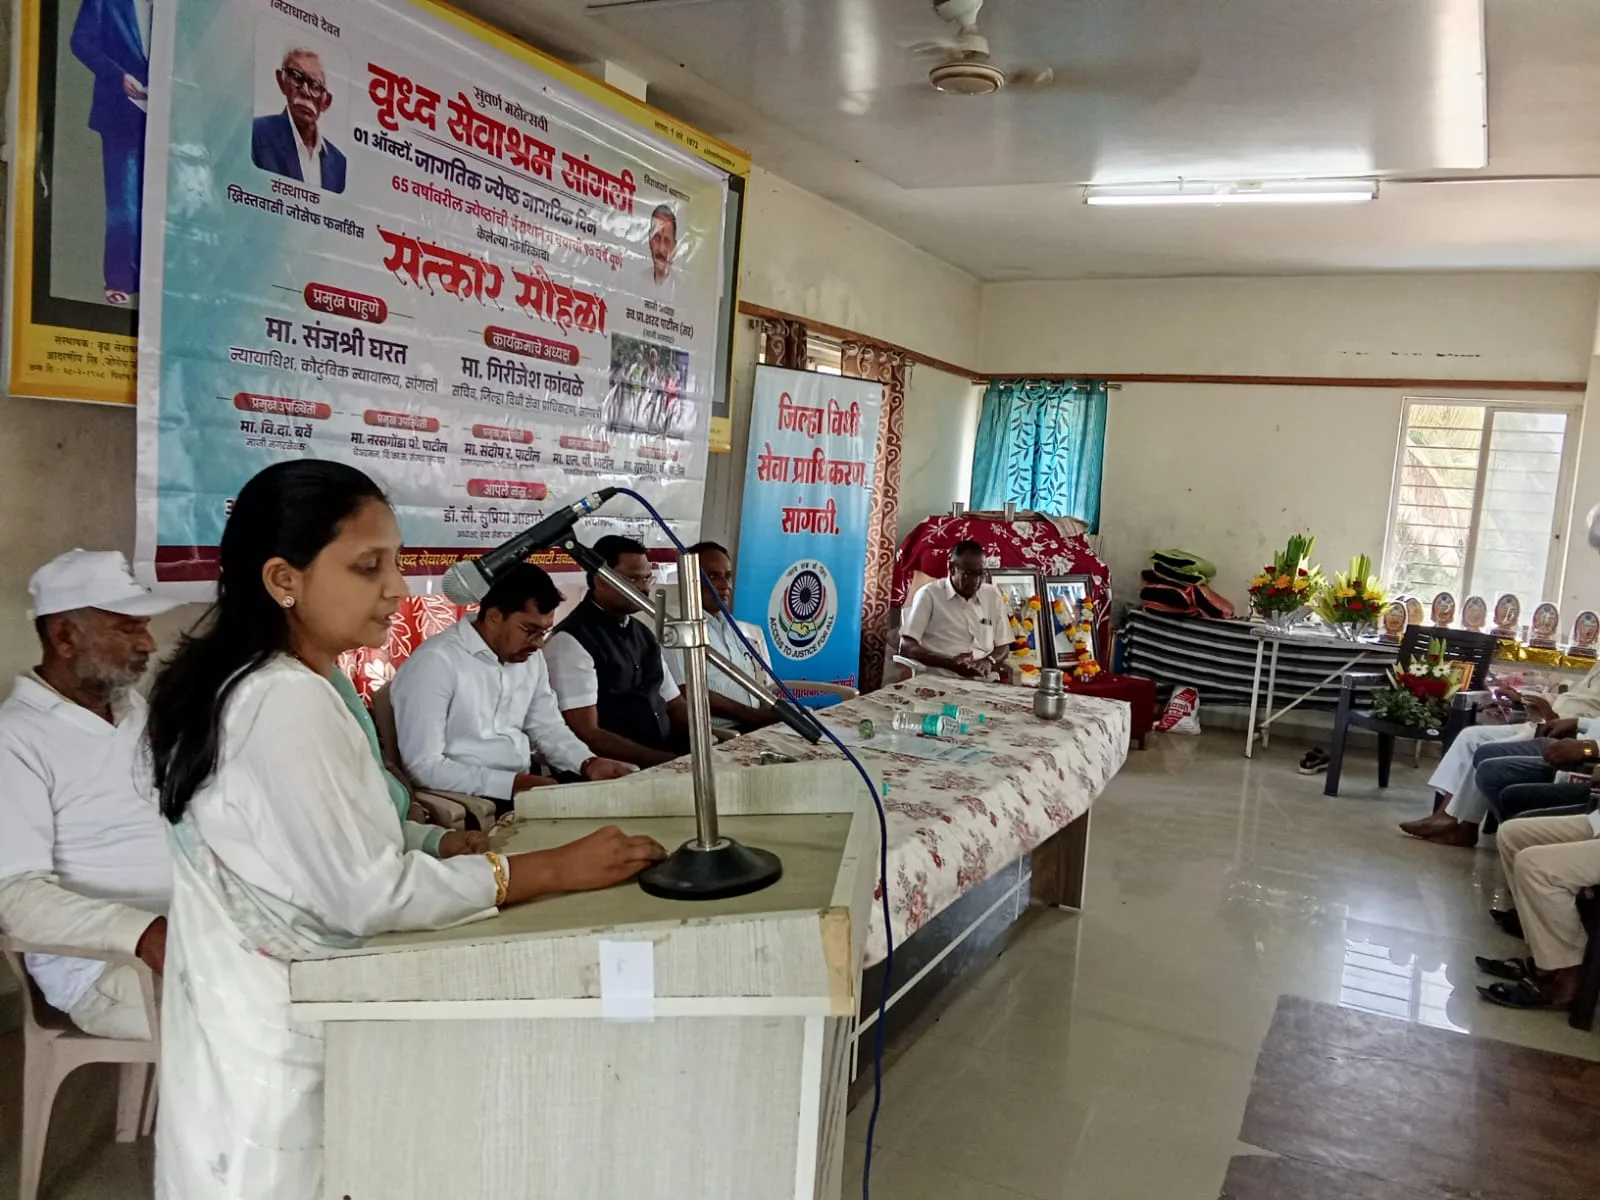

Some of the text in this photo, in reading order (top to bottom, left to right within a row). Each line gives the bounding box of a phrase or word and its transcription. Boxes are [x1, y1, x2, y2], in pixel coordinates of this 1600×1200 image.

[473, 86, 549, 132] सुवर्ण महोत्सवी
[368, 62, 441, 131] वृध्द
[447, 92, 556, 180] सेवाश्रम
[561, 154, 636, 215] सांगली
[353, 126, 369, 145] 01
[415, 150, 483, 191] जागतिक
[485, 176, 521, 205] ज्येष्ठ
[270, 179, 320, 205] संस्थापक
[392, 176, 408, 193] 65
[411, 180, 463, 211] वर्षावरील
[286, 204, 321, 226] जोसेफ
[476, 224, 508, 249] केलेल्या
[376, 224, 608, 338] सत्कार सोहळा
[312, 288, 379, 321] प्रमुख पाहुणे
[265, 317, 408, 365] मा. संजश्री घरत
[492, 332, 570, 362] कार्यक्रमाचे अध्यक्ष
[301, 355, 349, 381] कौटुंबिक
[352, 367, 402, 390] न्यायालय,
[461, 356, 584, 397] मा. गिरीजेश कांबळे
[480, 387, 504, 406] जिल्हा
[240, 420, 257, 434] मा.
[777, 392, 862, 439] जिल्हा विधी
[351, 432, 364, 444] मा.
[422, 438, 448, 453] पाटील
[464, 443, 478, 456] मा.
[480, 442, 504, 458] संदीप
[515, 446, 541, 462] पाटील
[757, 442, 790, 482] सेवा
[483, 482, 509, 497] आपले
[444, 506, 458, 523] डॉ.
[460, 505, 476, 523] सौ.
[479, 508, 509, 528] सुप्रिया
[781, 497, 840, 535] सांगली.
[770, 614, 835, 658] ACCESS TO JUSTICE FOR ALL
